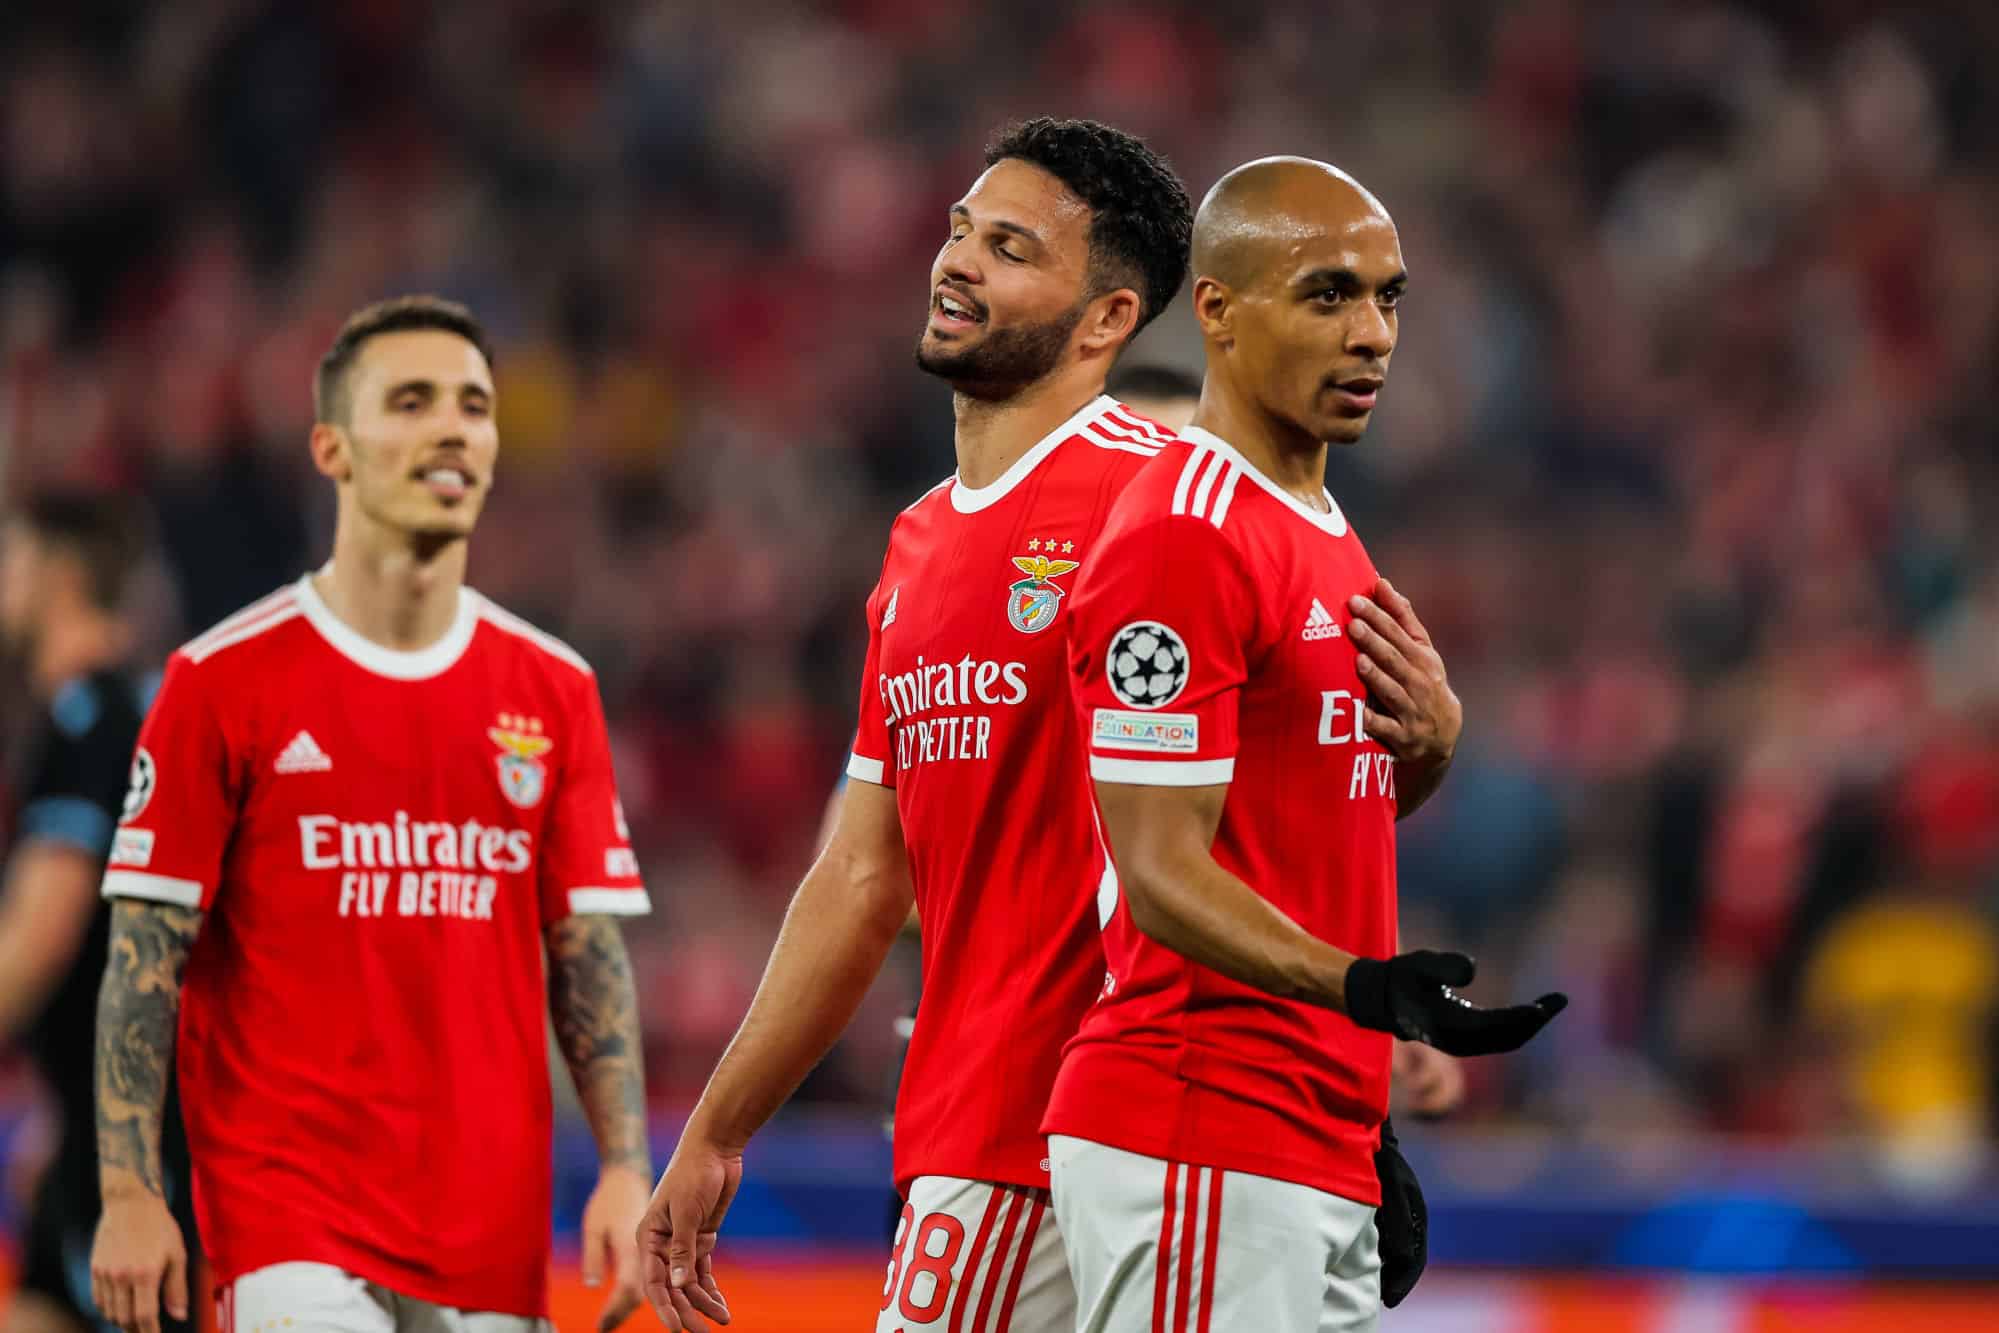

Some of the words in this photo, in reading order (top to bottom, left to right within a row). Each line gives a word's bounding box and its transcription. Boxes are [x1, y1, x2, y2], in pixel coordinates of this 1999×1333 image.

[1302, 624, 1342, 641] adidas
[298, 810, 532, 873] Emirates
[338, 872, 390, 917] FLY
[398, 872, 497, 920] BETTER
